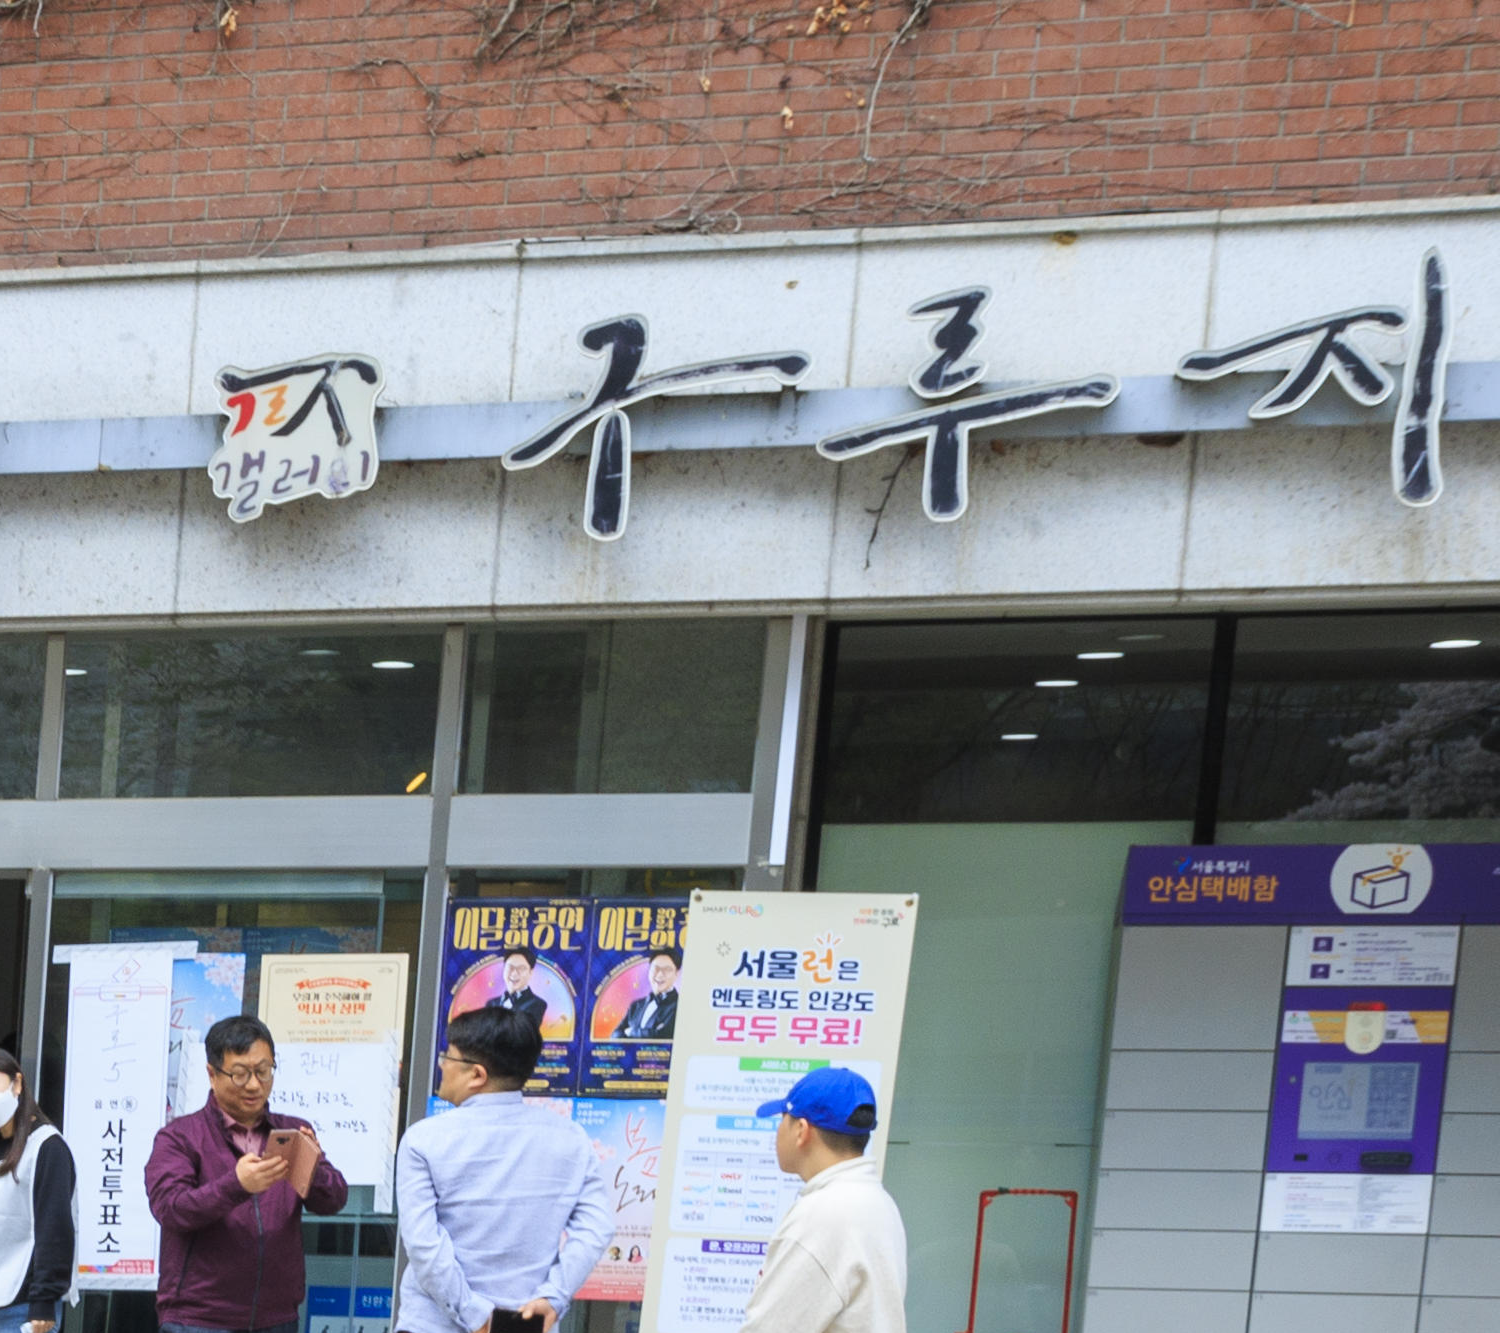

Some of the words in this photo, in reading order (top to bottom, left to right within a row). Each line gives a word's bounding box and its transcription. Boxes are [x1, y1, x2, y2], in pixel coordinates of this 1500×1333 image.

[503, 247, 1445, 540] 구루지
[214, 450, 374, 515] 갤러리
[1191, 860, 1250, 874] 서울특별시
[1148, 876, 1279, 902] 안심택배함
[532, 907, 585, 951] 공연
[733, 948, 860, 983] 서울런은
[712, 988, 799, 1010] 멘토링도
[809, 990, 875, 1012] 인강도
[716, 1015, 778, 1044] 모두
[789, 1017, 862, 1046] 무료!
[300, 1051, 341, 1077] 관내
[97, 1118, 127, 1254] 사전투표소
